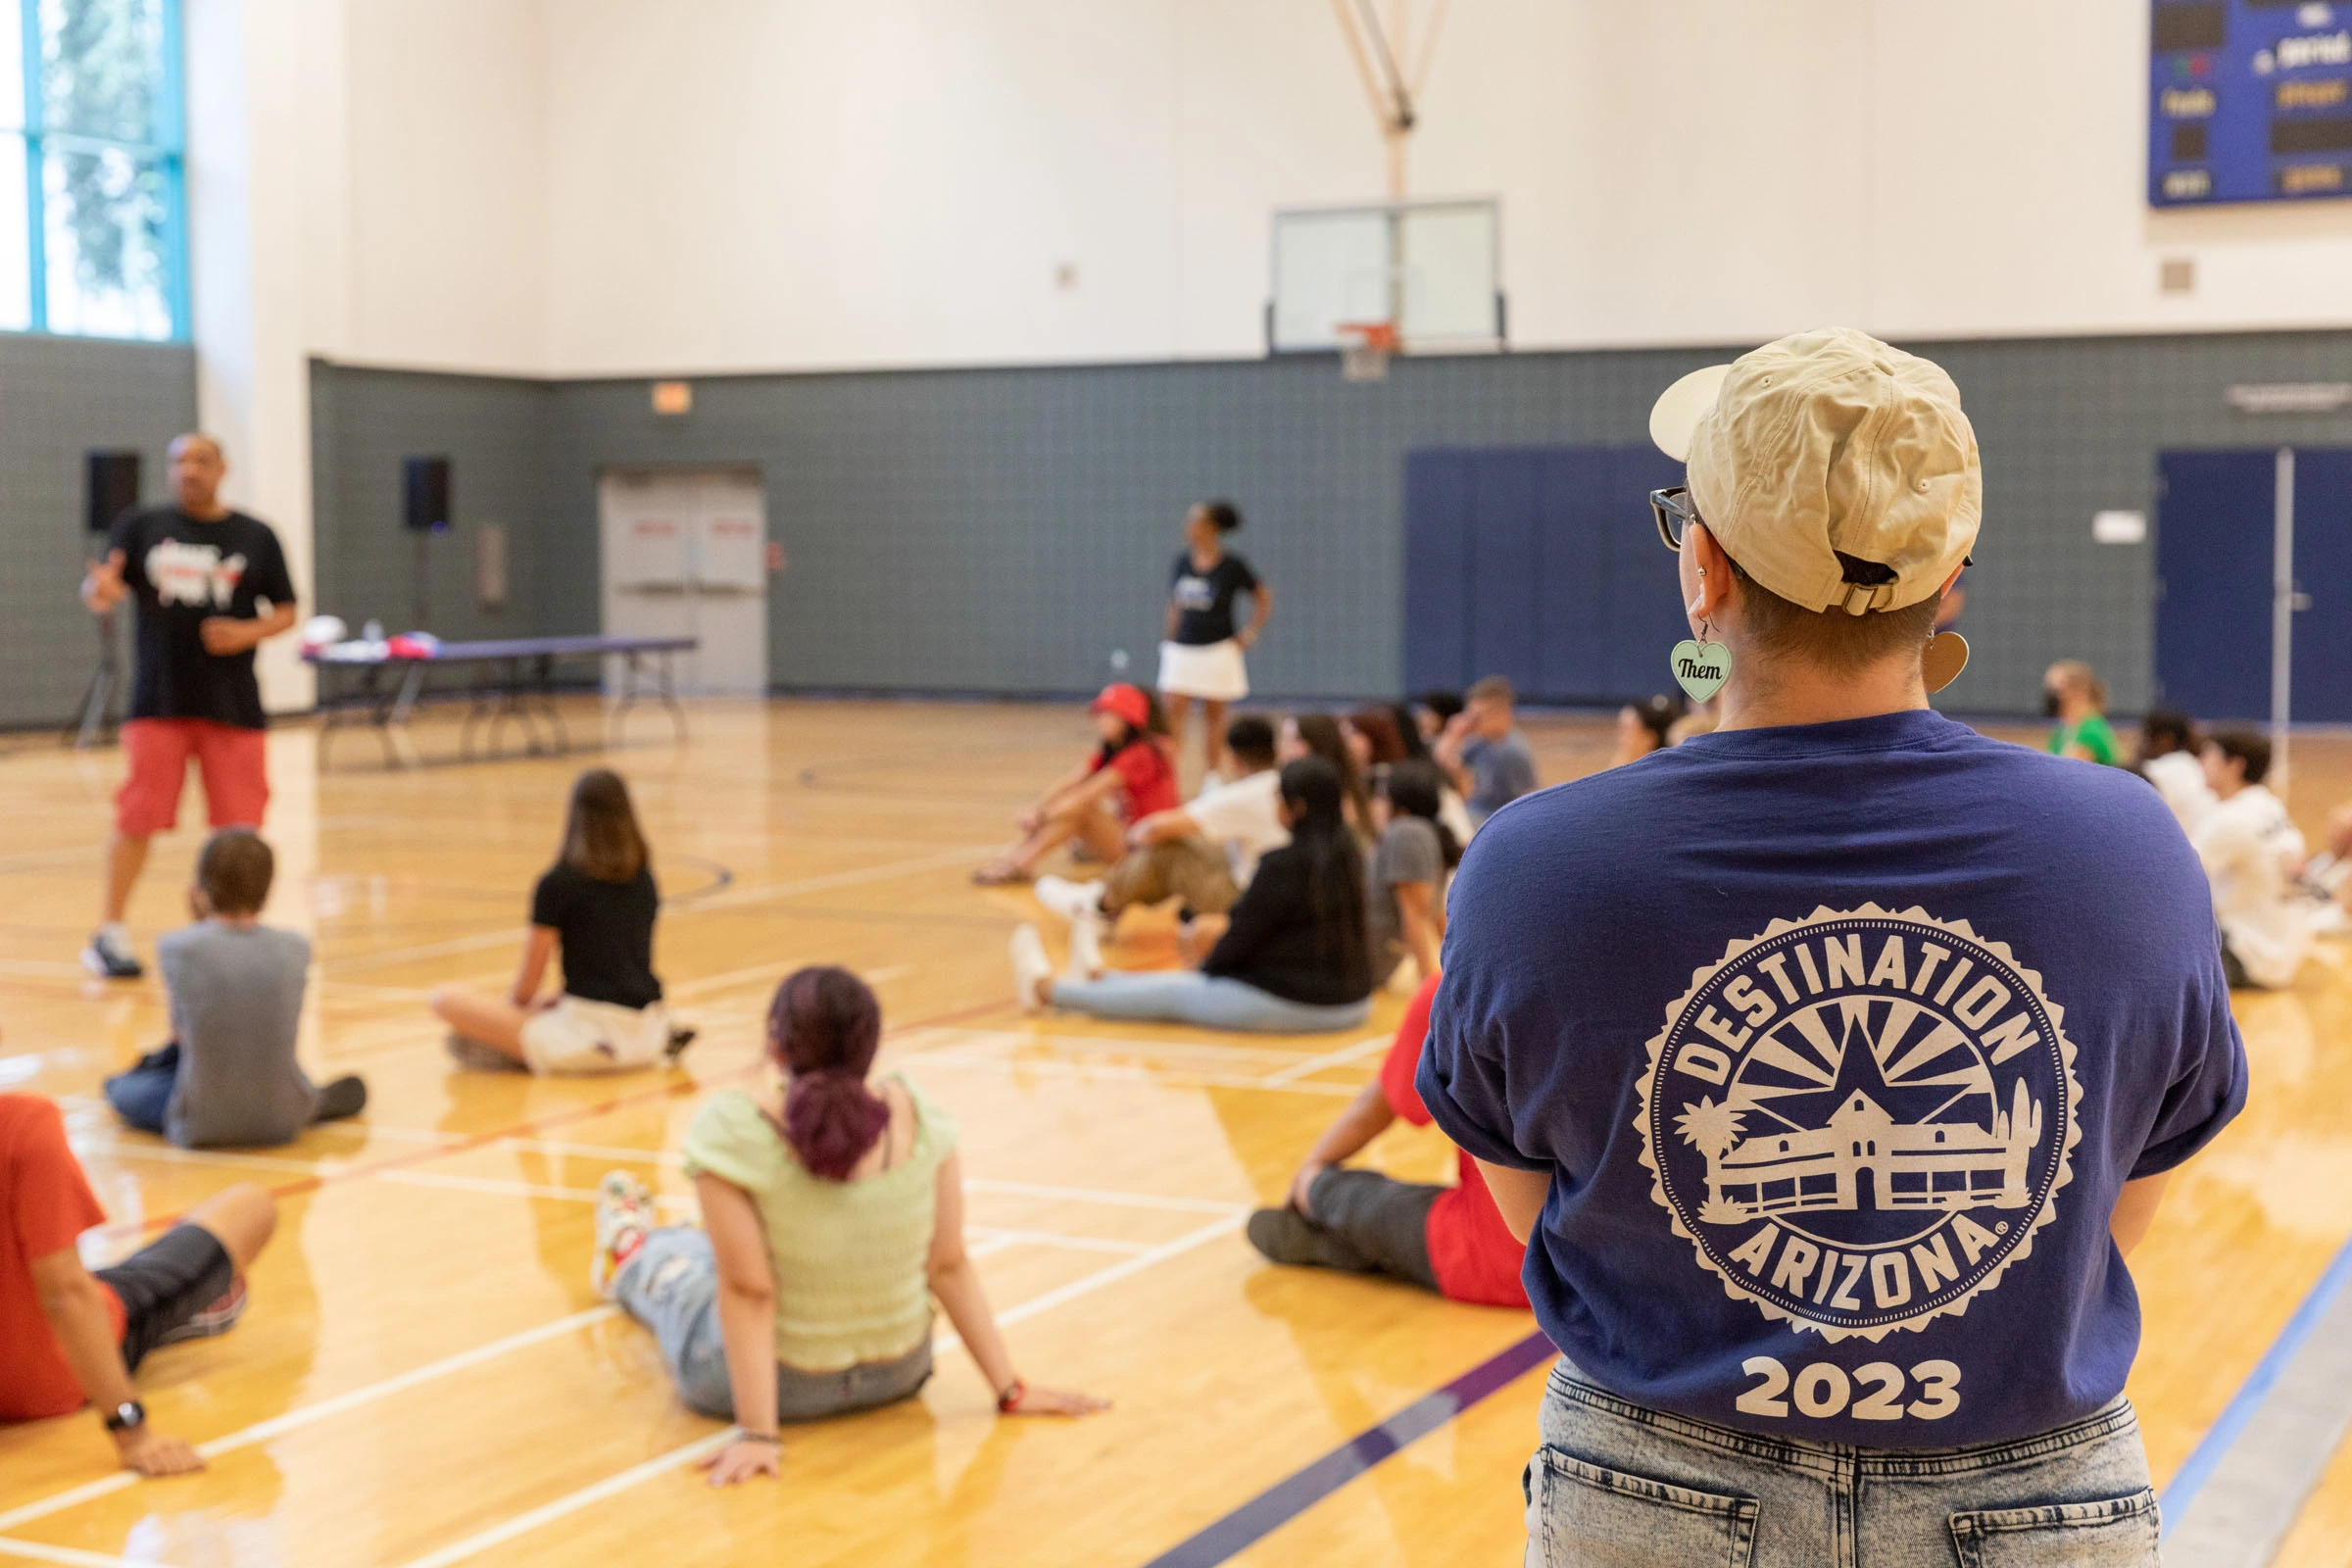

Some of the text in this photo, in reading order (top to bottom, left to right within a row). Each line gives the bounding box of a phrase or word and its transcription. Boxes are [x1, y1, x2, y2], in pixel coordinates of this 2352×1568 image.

[1678, 658, 1723, 680] Them
[1673, 934, 2041, 1086] DESTINATION
[1736, 1355, 1962, 1421] 2023
